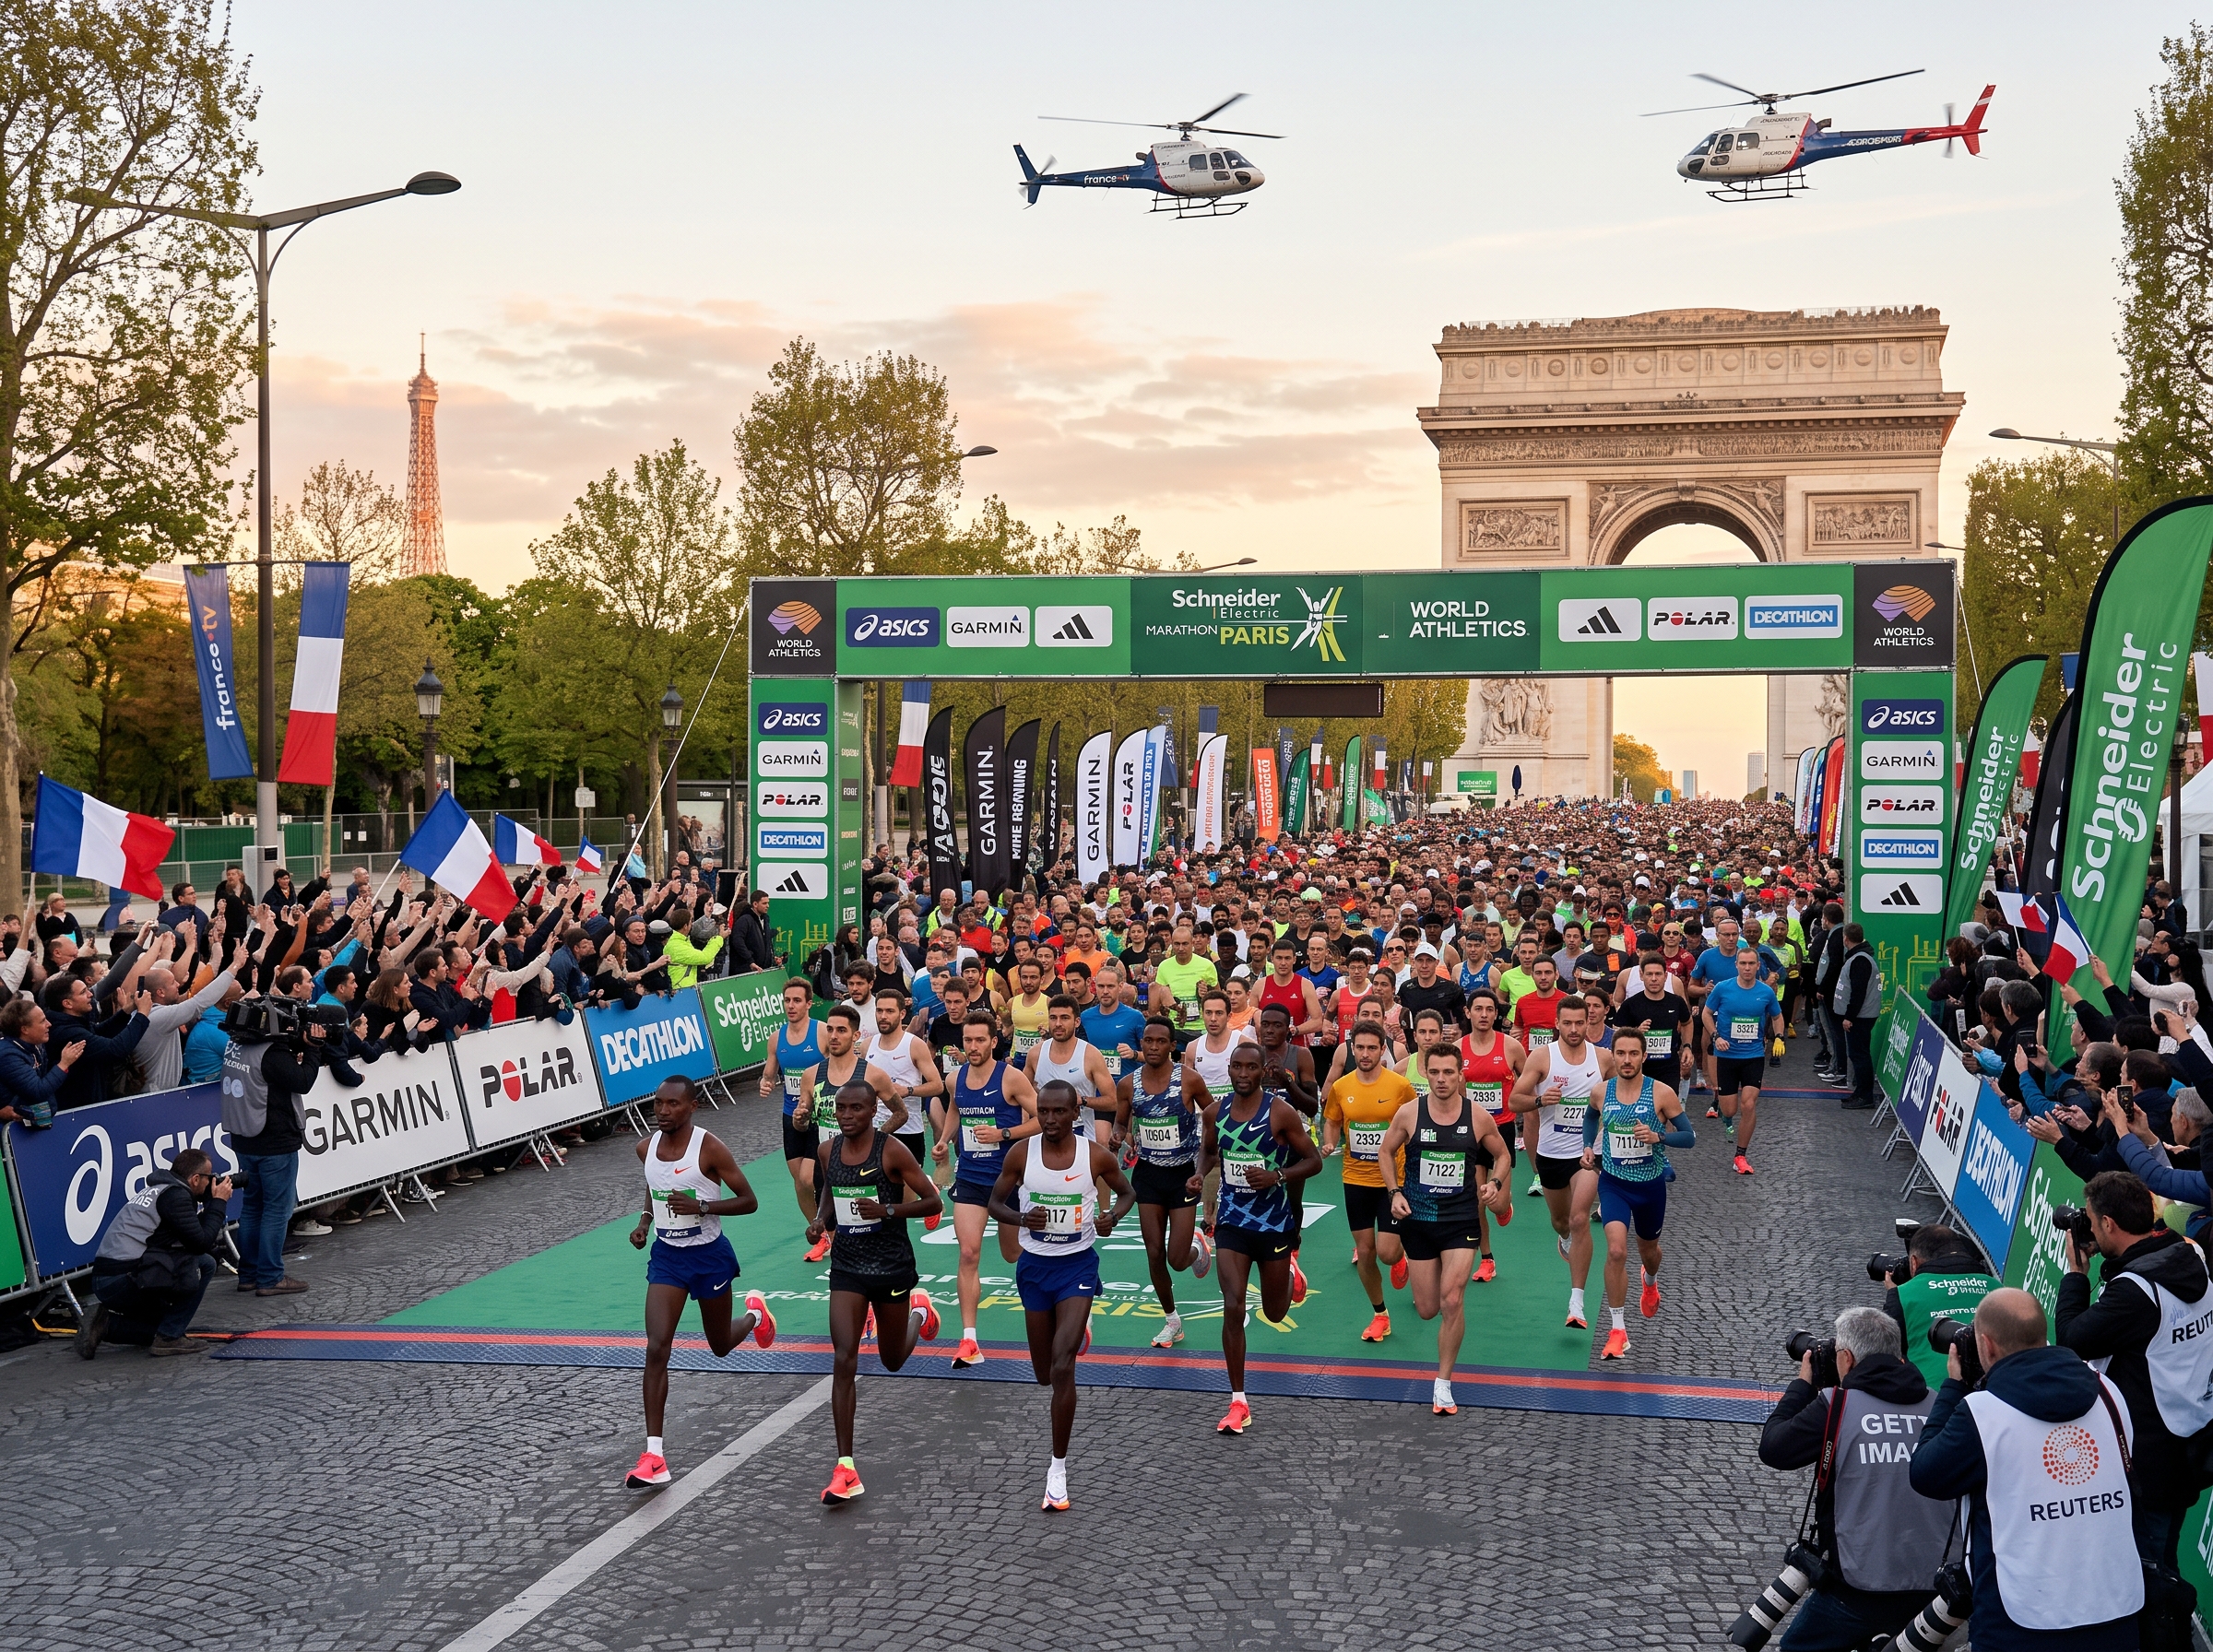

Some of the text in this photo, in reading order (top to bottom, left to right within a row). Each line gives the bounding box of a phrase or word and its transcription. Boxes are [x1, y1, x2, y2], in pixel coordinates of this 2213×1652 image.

[1172, 588, 1281, 608] Schneider
[1220, 608, 1280, 619] Electric
[1410, 601, 1490, 619] WORLD
[1653, 611, 1731, 626] POLAR
[1754, 609, 1833, 624] DECATHLON
[879, 619, 930, 637] asics
[952, 621, 1023, 634] GARMIN
[1146, 625, 1290, 645] MARATHON PARIS
[1409, 620, 1527, 638] ATHLETICS
[1883, 628, 1924, 636] WORLD
[776, 639, 813, 648] WORLD
[1874, 637, 1935, 646] ATHLETICS
[768, 648, 821, 657] ATHLETICS
[782, 713, 822, 726] asics
[1889, 710, 1936, 726] asics
[2126, 643, 2177, 793] Electric
[763, 755, 822, 765] GARMIN
[1866, 756, 1936, 767] GARMIN
[2071, 633, 2147, 903] Schneider
[762, 794, 822, 806] POLAR
[977, 751, 997, 856] GARMIN
[1122, 762, 1134, 830] POLAR
[1866, 798, 1935, 811] POLAR
[1960, 726, 2005, 871] Schneider
[1087, 759, 1101, 862] GARMIN
[763, 835, 822, 846] DECATHLON
[1868, 843, 1935, 856] DECATHLON
[714, 985, 784, 1028] Schneider
[600, 1014, 704, 1076] DECATHLON
[480, 1046, 577, 1108] POLAR
[303, 1080, 444, 1156] GARMIN
[1929, 1084, 1964, 1156] POLAR
[1355, 1133, 1381, 1146] 2332
[1427, 1162, 1456, 1177] 7122
[1965, 1118, 2023, 1225] DECATHLON
[1928, 1277, 1988, 1290] Schneider
[1858, 1442, 1919, 1465] IMA
[2030, 1490, 2124, 1522] REUTERS
